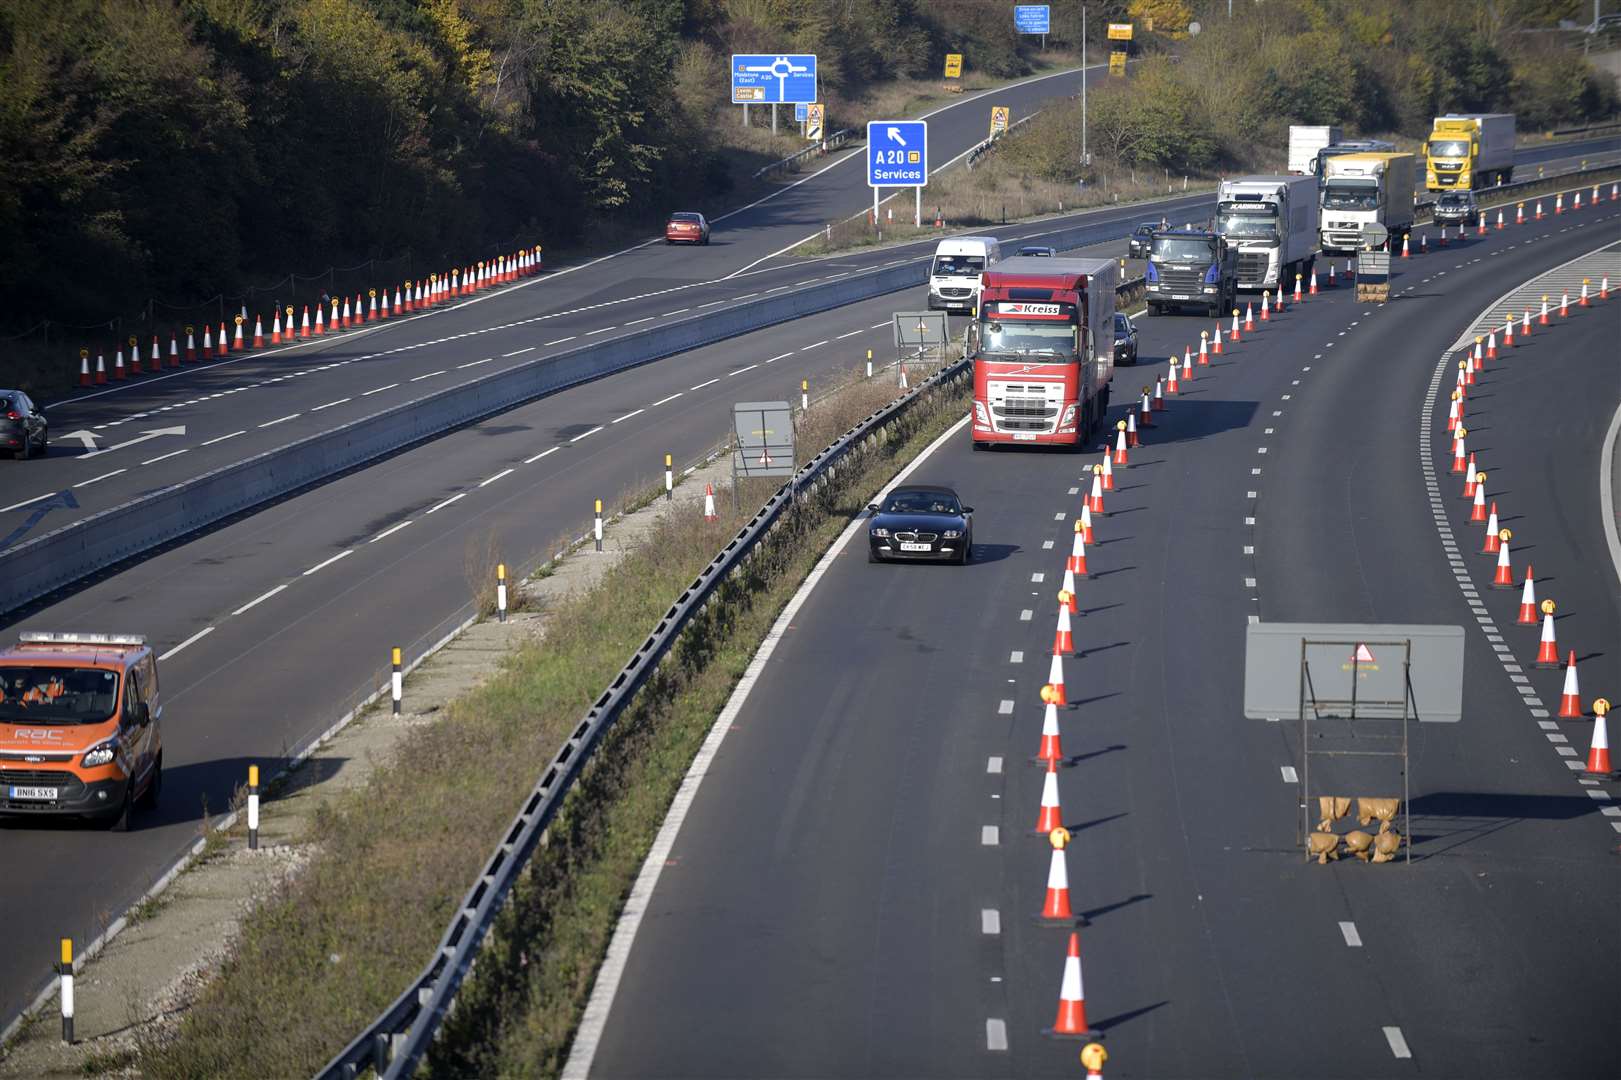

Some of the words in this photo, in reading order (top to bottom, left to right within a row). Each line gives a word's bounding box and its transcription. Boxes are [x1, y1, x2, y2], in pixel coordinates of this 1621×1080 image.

[874, 169, 921, 180] Services
[1024, 304, 1059, 314] Kreiss
[37, 788, 55, 797] SXS
